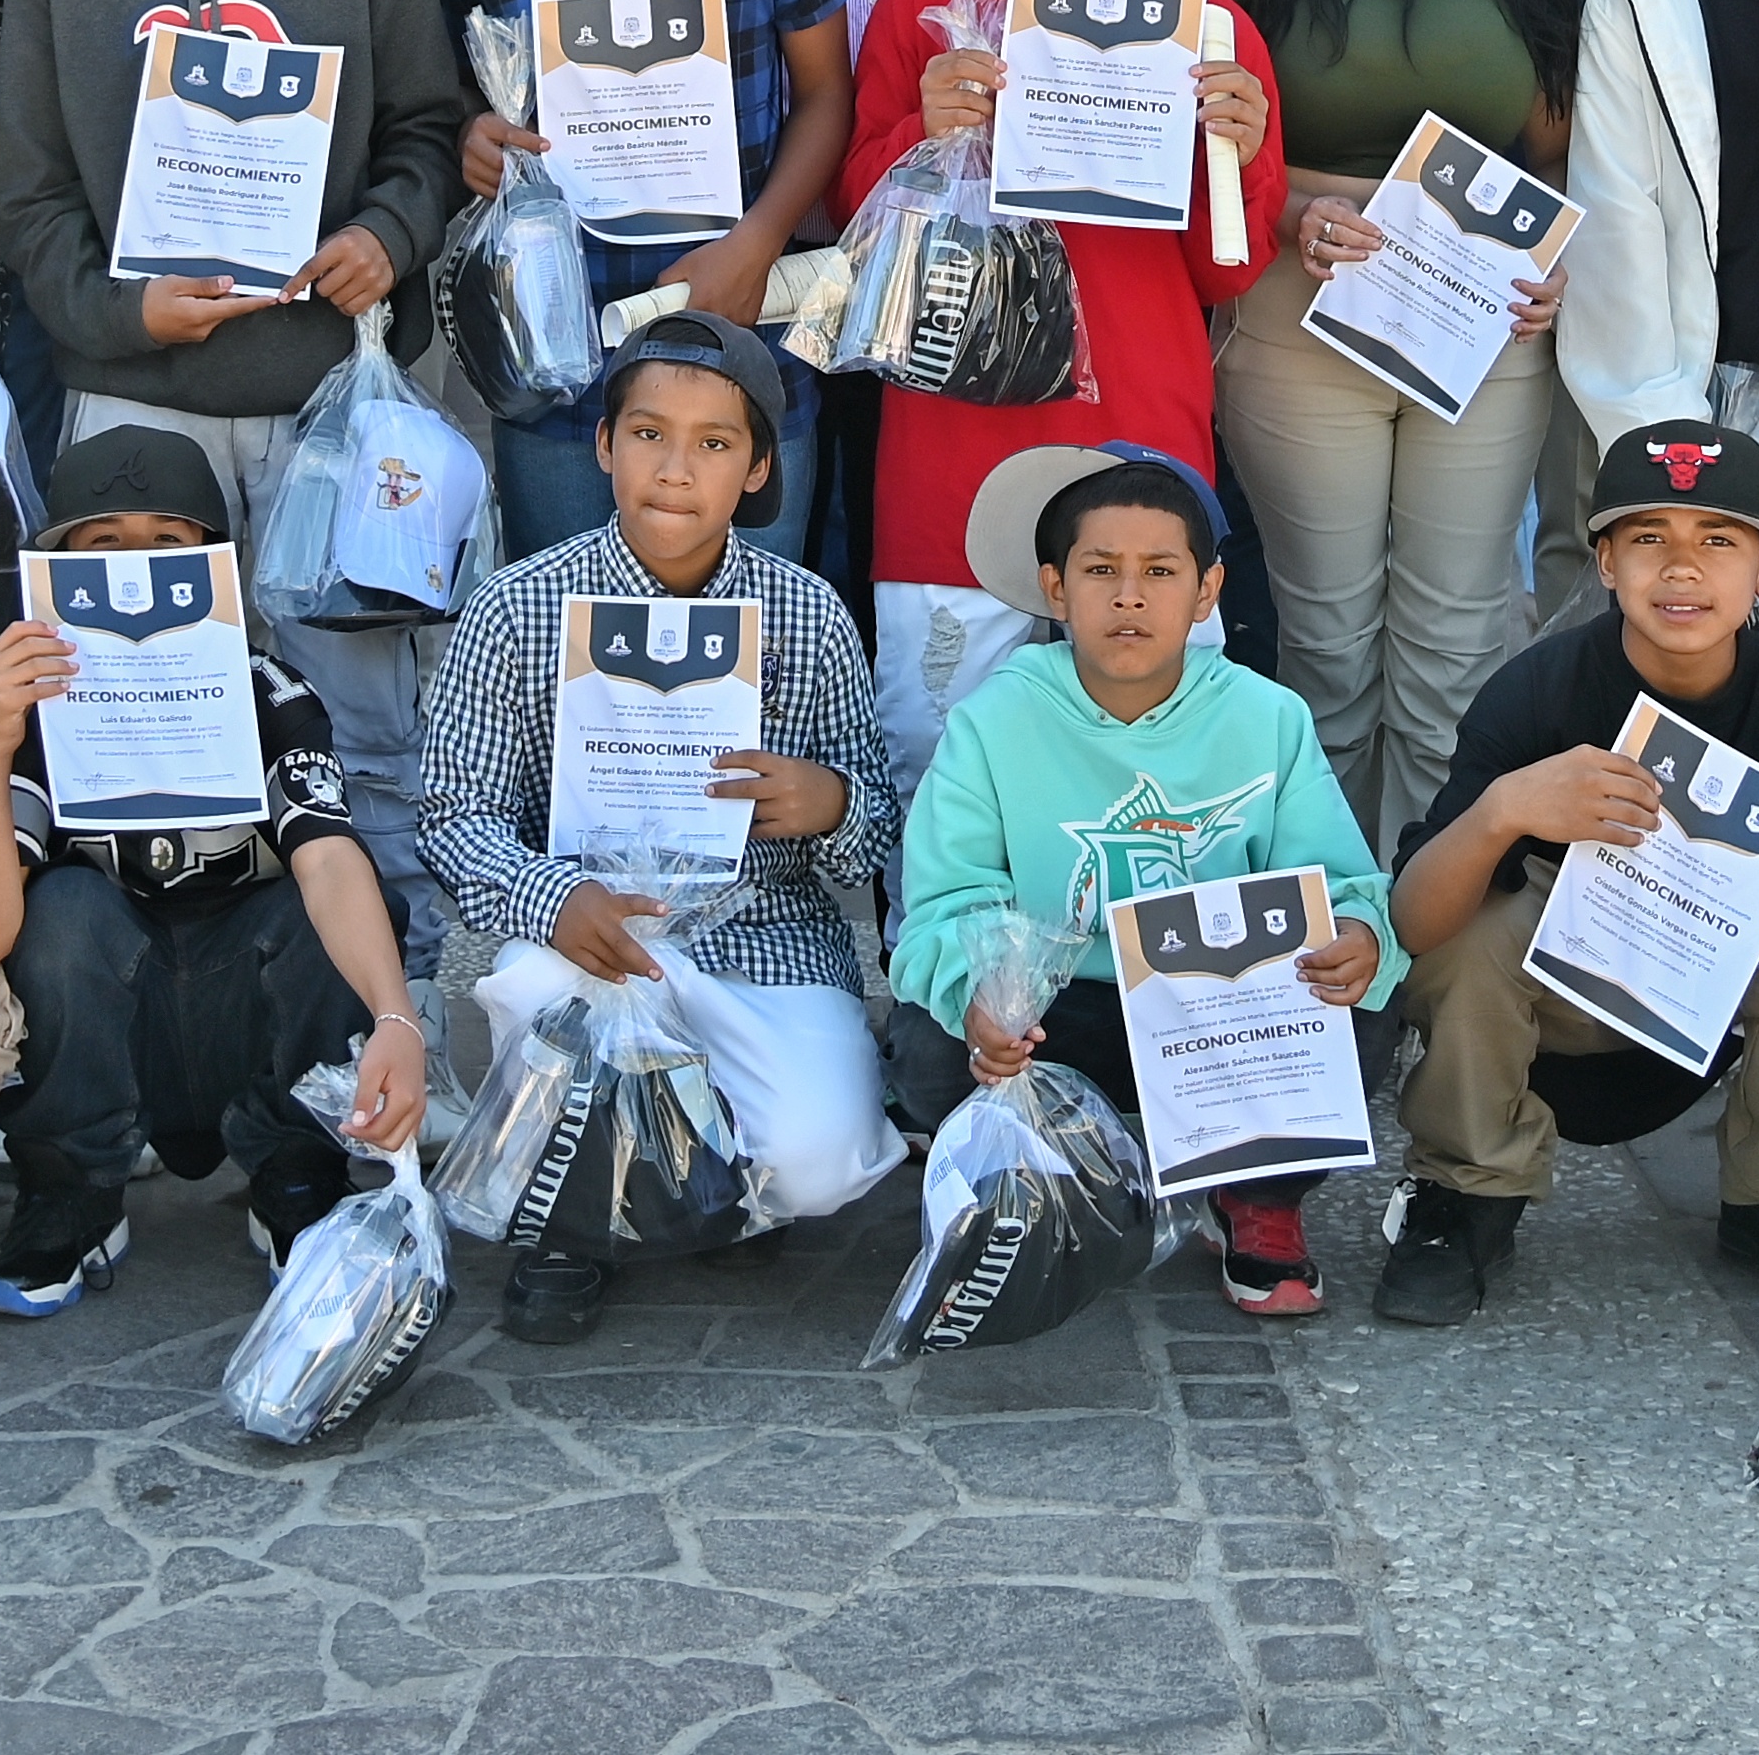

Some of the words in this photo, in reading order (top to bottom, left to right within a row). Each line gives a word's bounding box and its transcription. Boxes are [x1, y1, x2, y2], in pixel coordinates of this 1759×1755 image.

[1025, 89, 1170, 115] RECONOCIMIENTO
[566, 114, 711, 135] RECONOCIMIENTO
[1057, 115, 1068, 123] de
[155, 156, 301, 185] RECONOCIMIENTO
[1376, 232, 1499, 316] RECONOCIMIENTO
[65, 685, 224, 704] RECONOCIMIENTO
[119, 714, 156, 723] Eduardo
[616, 766, 652, 776] Eduardo
[1593, 845, 1740, 940] RECONOCIMIENTO
[1160, 1019, 1325, 1058] RECONOCIMIENTO
[1182, 1060, 1229, 1076] Alexander
